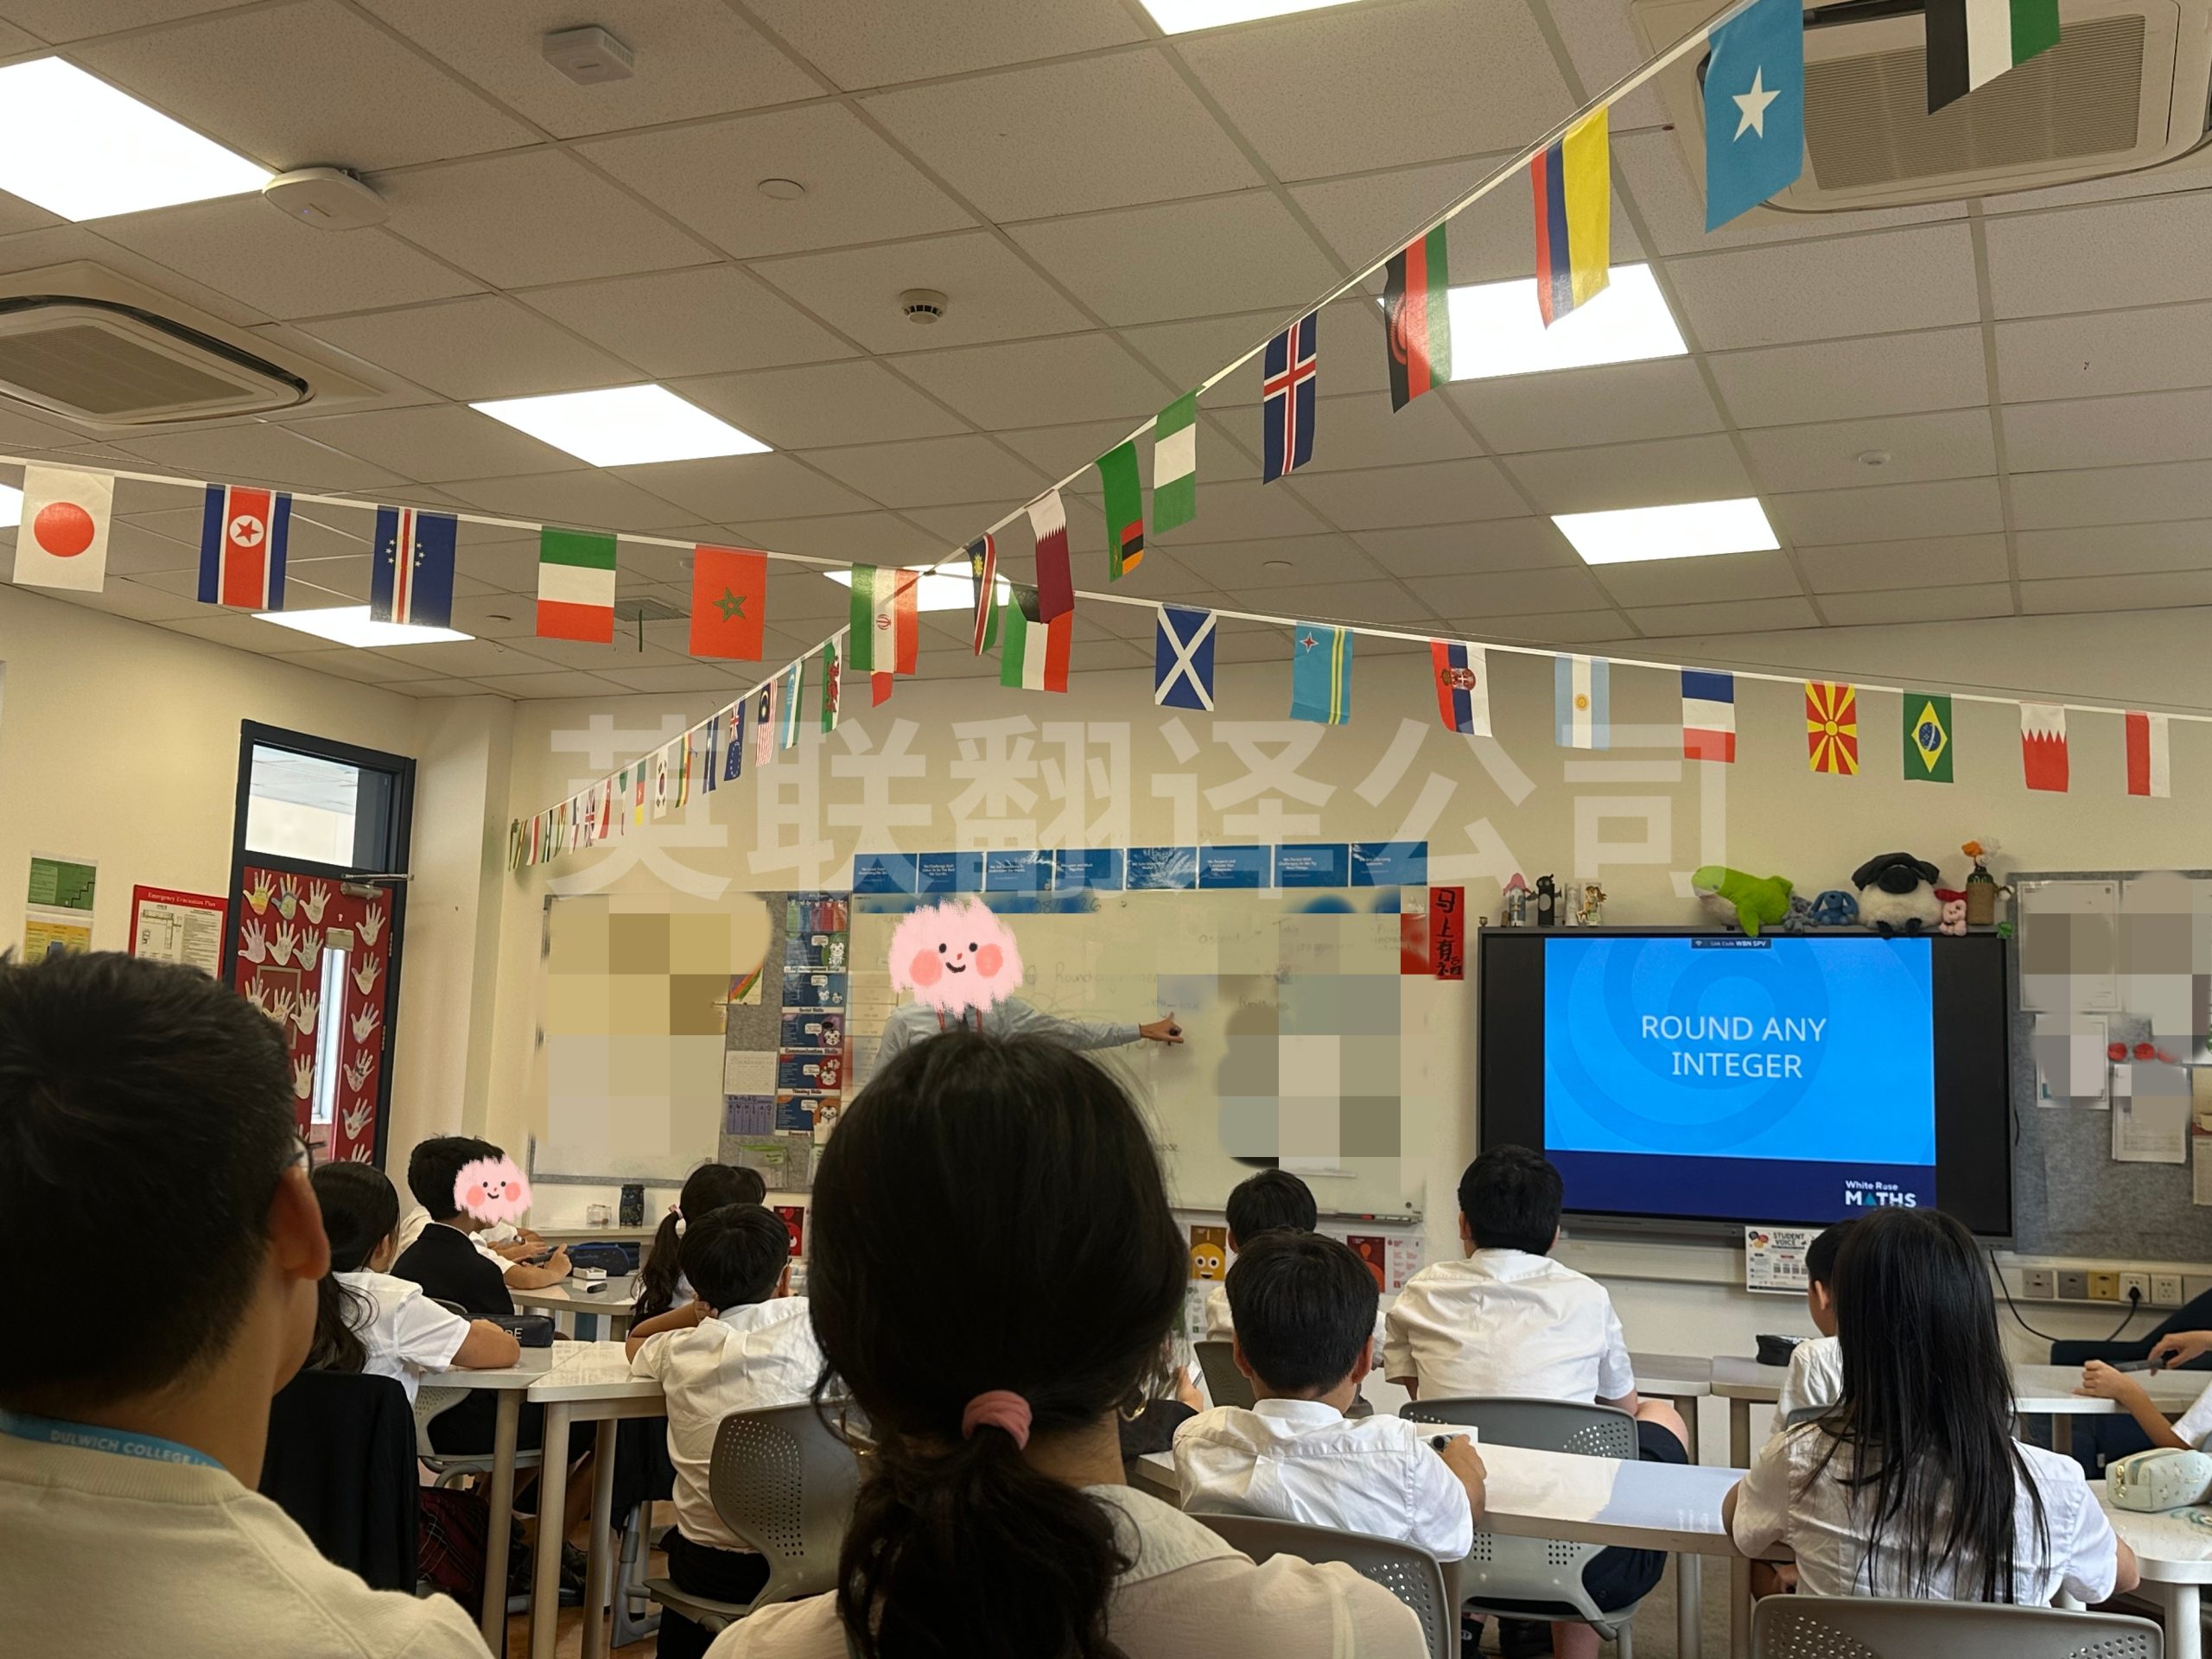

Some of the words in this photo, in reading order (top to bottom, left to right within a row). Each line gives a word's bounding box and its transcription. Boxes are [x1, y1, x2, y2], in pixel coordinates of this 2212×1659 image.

[1436, 888, 1462, 976] 马上有福
[1642, 1015, 1752, 1040] ROUND
[1762, 1017, 1827, 1042] ANY
[1671, 1052, 1802, 1078] INTEGER
[1845, 1180, 1874, 1190] White
[50, 1429, 119, 1451] DULWICH
[123, 1442, 190, 1465] COLLEGE
